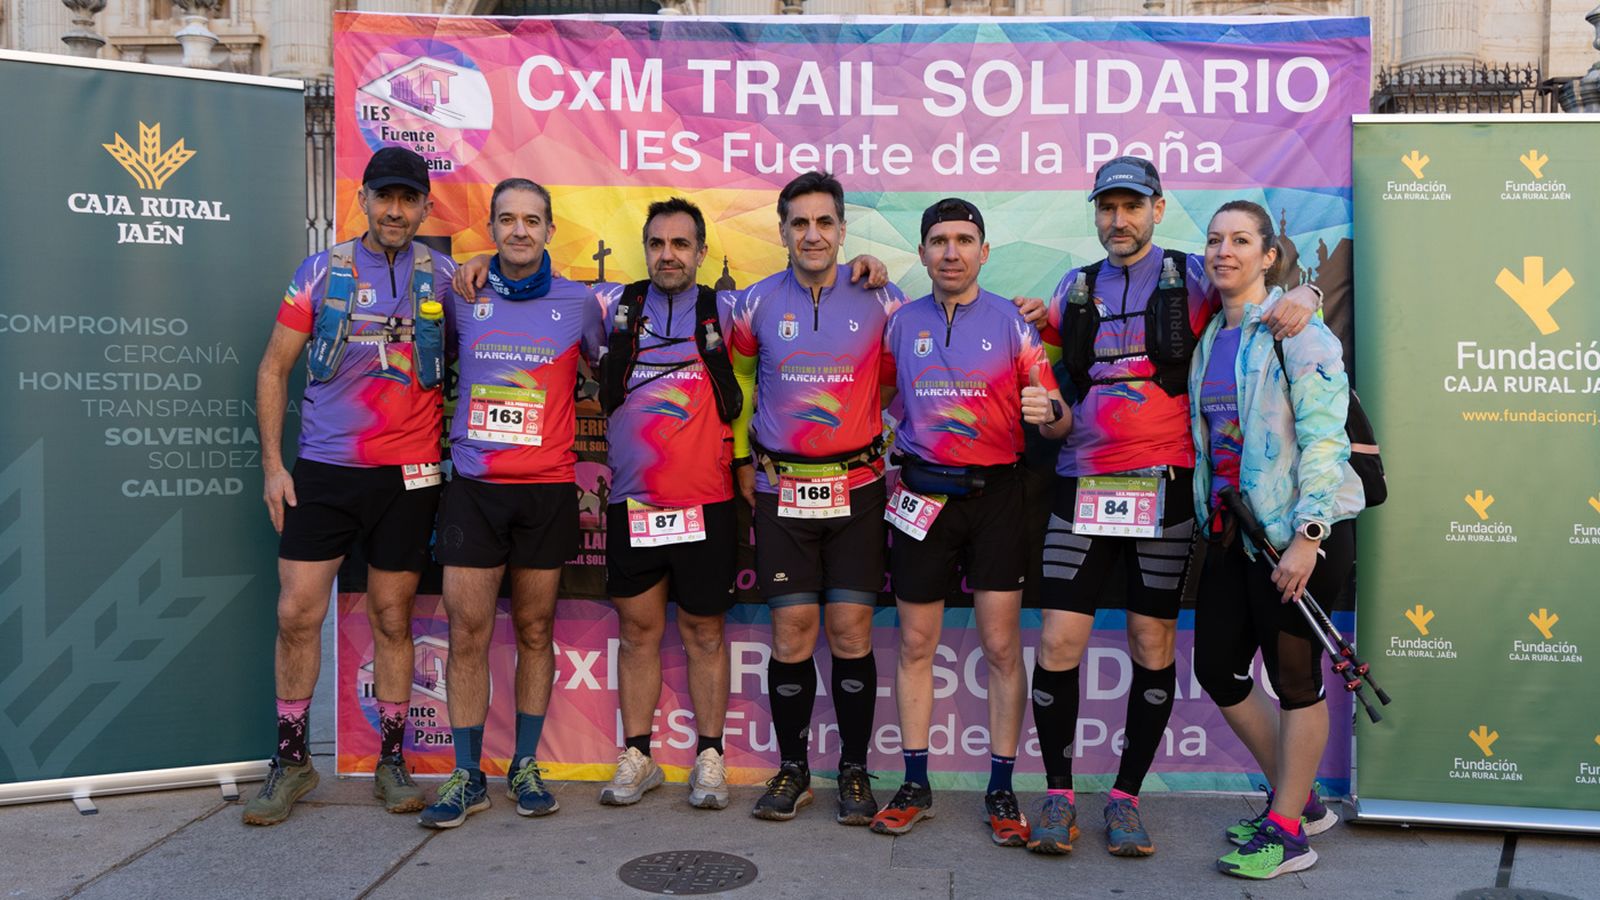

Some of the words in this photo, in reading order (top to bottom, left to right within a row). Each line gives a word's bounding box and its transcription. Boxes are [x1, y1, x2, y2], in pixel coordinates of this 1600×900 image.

[517, 54, 663, 113] CxM
[687, 59, 898, 117] TRAIL
[922, 57, 1330, 117] SOLIDARIO
[363, 105, 391, 121] IES
[381, 126, 435, 142] Fuente
[414, 143, 425, 153] de
[427, 143, 436, 153] la
[620, 128, 702, 171] IES
[723, 132, 912, 175] Fuente
[931, 132, 1000, 176] de
[1020, 131, 1063, 175] la
[424, 156, 452, 171] eña
[1387, 180, 1447, 193] Fundación
[1505, 180, 1566, 193] Fundación
[1431, 192, 1451, 201] JAÉN
[1550, 192, 1571, 201] JAÉN
[67, 192, 136, 217] CAJA
[140, 196, 231, 222] RURAL
[117, 220, 185, 246] JAÉN
[1170, 297, 1183, 359] KIPRUN
[104, 342, 240, 365] CERCANÍA
[475, 351, 522, 361] MANCHA
[525, 353, 555, 365] REAL
[1457, 340, 1600, 371] Fundació
[18, 371, 203, 392] HONESTIDAD
[677, 371, 703, 380] REAL
[781, 373, 825, 383] MANCHA
[827, 374, 855, 383] REAL
[1444, 375, 1498, 393] CAJA
[1504, 376, 1576, 393] RURAL
[1581, 377, 1600, 394] JA
[915, 388, 958, 397] MANCHA
[960, 388, 987, 397] REAL
[81, 399, 300, 418] TRANSPARENA
[489, 408, 523, 425] 163
[105, 426, 259, 447] SOLVENCIA
[148, 449, 259, 470] SOLIDEZ
[121, 476, 244, 498] CALIDAD
[797, 486, 830, 500] 168
[901, 495, 919, 513] 85
[1105, 499, 1129, 515] 84
[655, 513, 678, 529] 87
[1450, 521, 1512, 534] Fundación
[1445, 534, 1467, 542] CAJA
[1468, 534, 1495, 543] RURAL
[1496, 534, 1518, 543] JAÉN
[1569, 536, 1591, 545] CAJA
[1390, 636, 1453, 650] Fundación
[1513, 640, 1577, 654] Fundación
[1386, 649, 1407, 657] CAJA
[1408, 650, 1435, 658] RURAL
[1436, 650, 1457, 659] JAÉN
[1509, 653, 1530, 661] CAJA
[1532, 654, 1559, 662] RURAL
[1561, 654, 1583, 663] JAÉN
[414, 719, 425, 727] de
[428, 719, 436, 727] la
[414, 728, 453, 745] Peña
[928, 713, 991, 756] de
[1454, 757, 1518, 772] Fundación
[1449, 771, 1470, 779] CAJA
[1472, 772, 1499, 780] RURAL
[1501, 772, 1523, 781] JAÉN
[1575, 775, 1597, 784] CAJA
